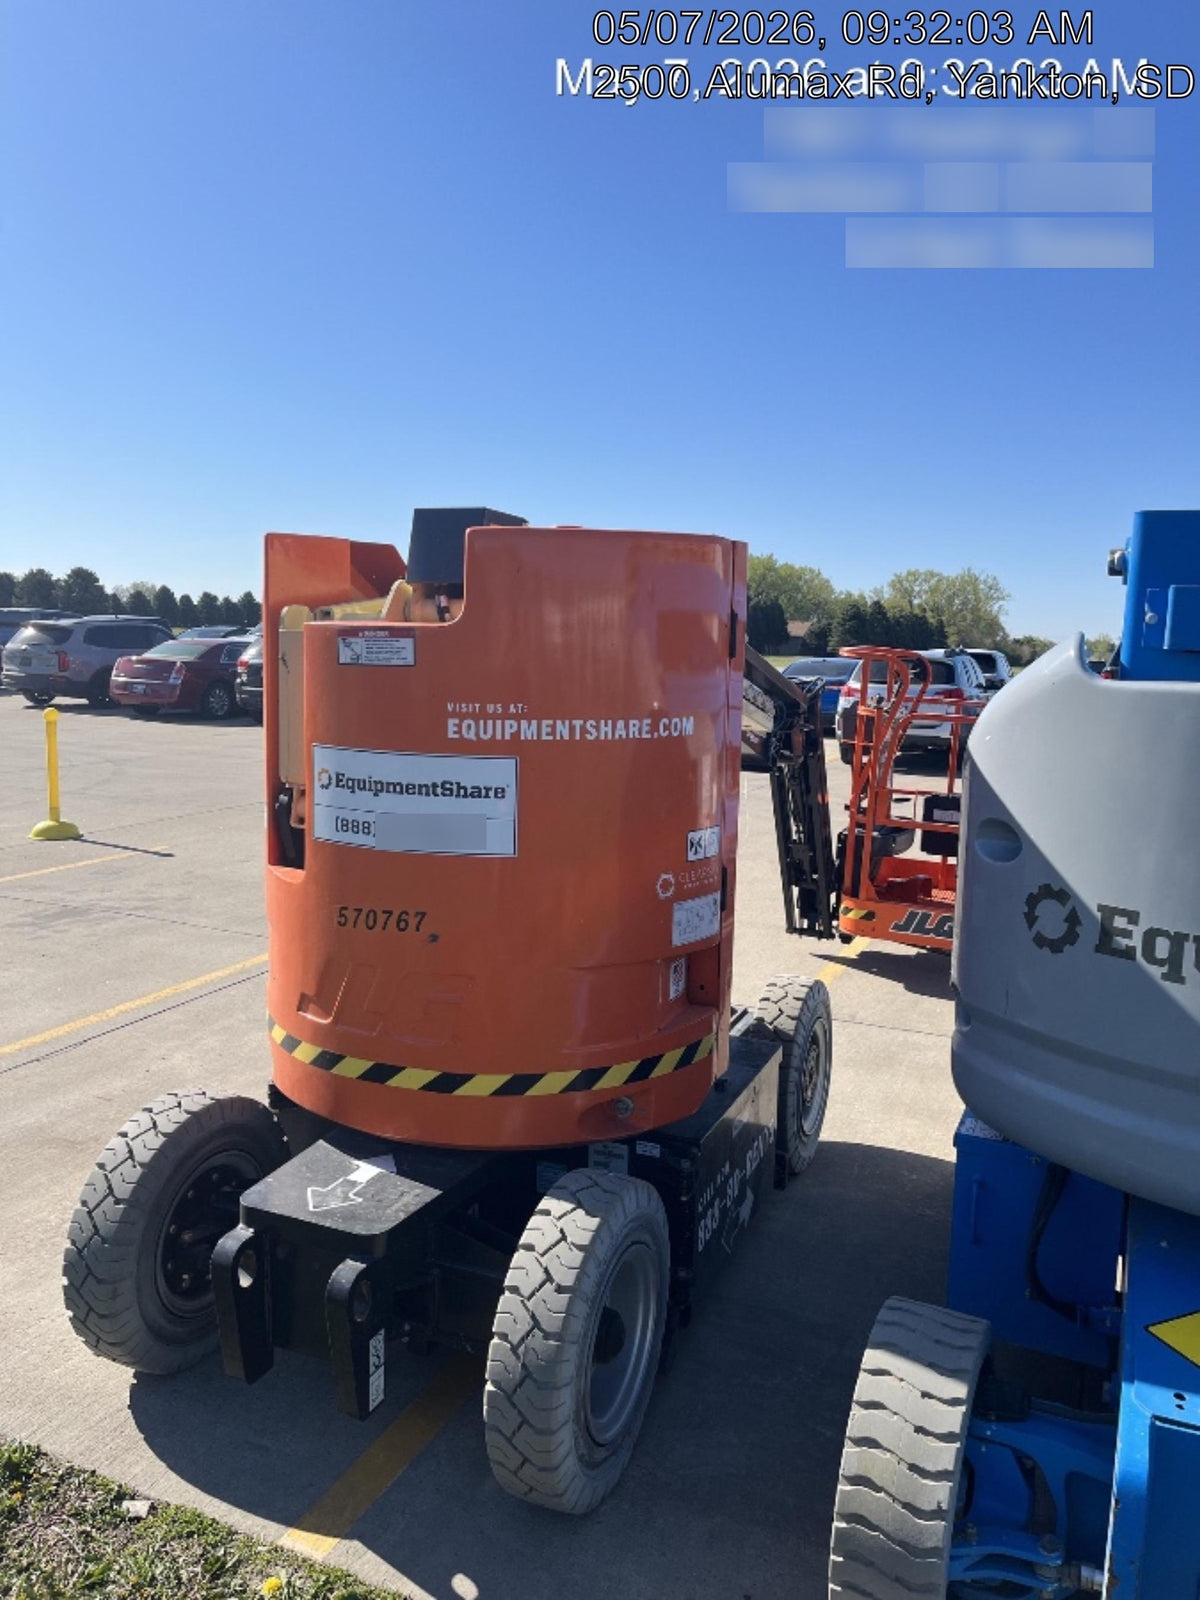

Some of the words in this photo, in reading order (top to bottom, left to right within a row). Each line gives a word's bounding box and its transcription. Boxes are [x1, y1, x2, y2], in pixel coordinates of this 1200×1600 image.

[447, 703, 481, 714] VISIT
[486, 703, 503, 714] US
[508, 703, 528, 714] AT:
[447, 716, 695, 741] EQUIPMENTSHARE.COM
[334, 772, 507, 800] EquipmentShare
[337, 906, 427, 932] 570767
[889, 908, 955, 940] JLG
[1094, 903, 1200, 985] Eq
